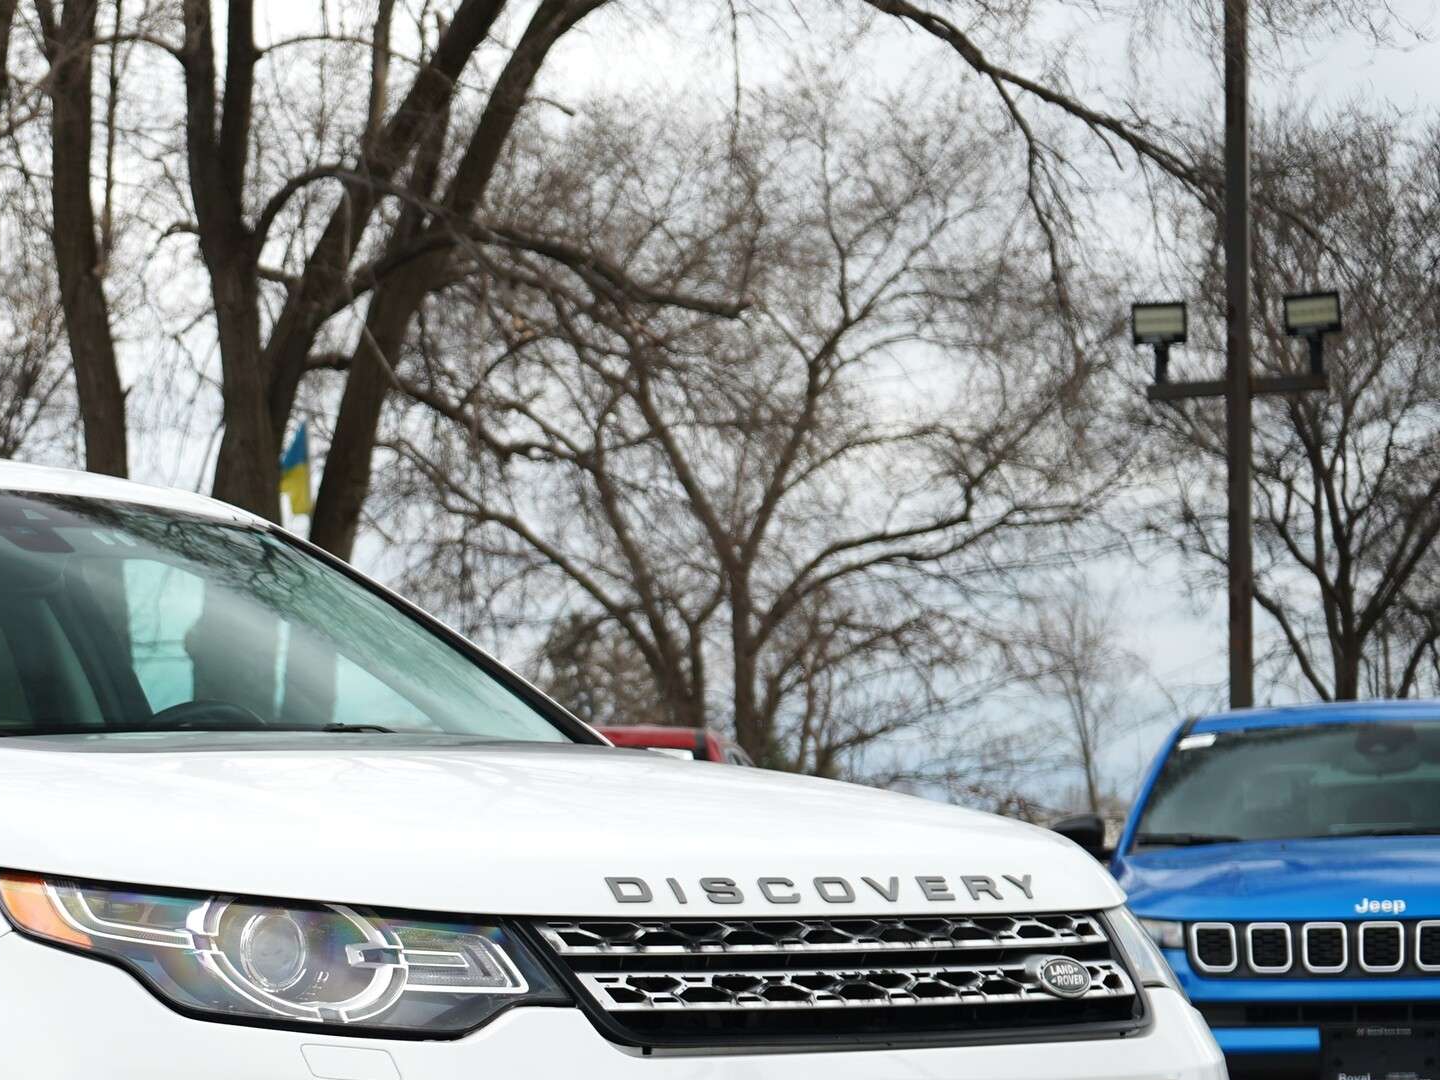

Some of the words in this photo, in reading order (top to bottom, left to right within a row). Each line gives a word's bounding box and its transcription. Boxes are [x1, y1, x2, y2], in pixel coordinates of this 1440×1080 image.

[603, 873, 1036, 905] DISCOVERY
[1354, 898, 1407, 915] Jeep
[1049, 963, 1074, 976] LAND
[1056, 974, 1085, 987] ROVER
